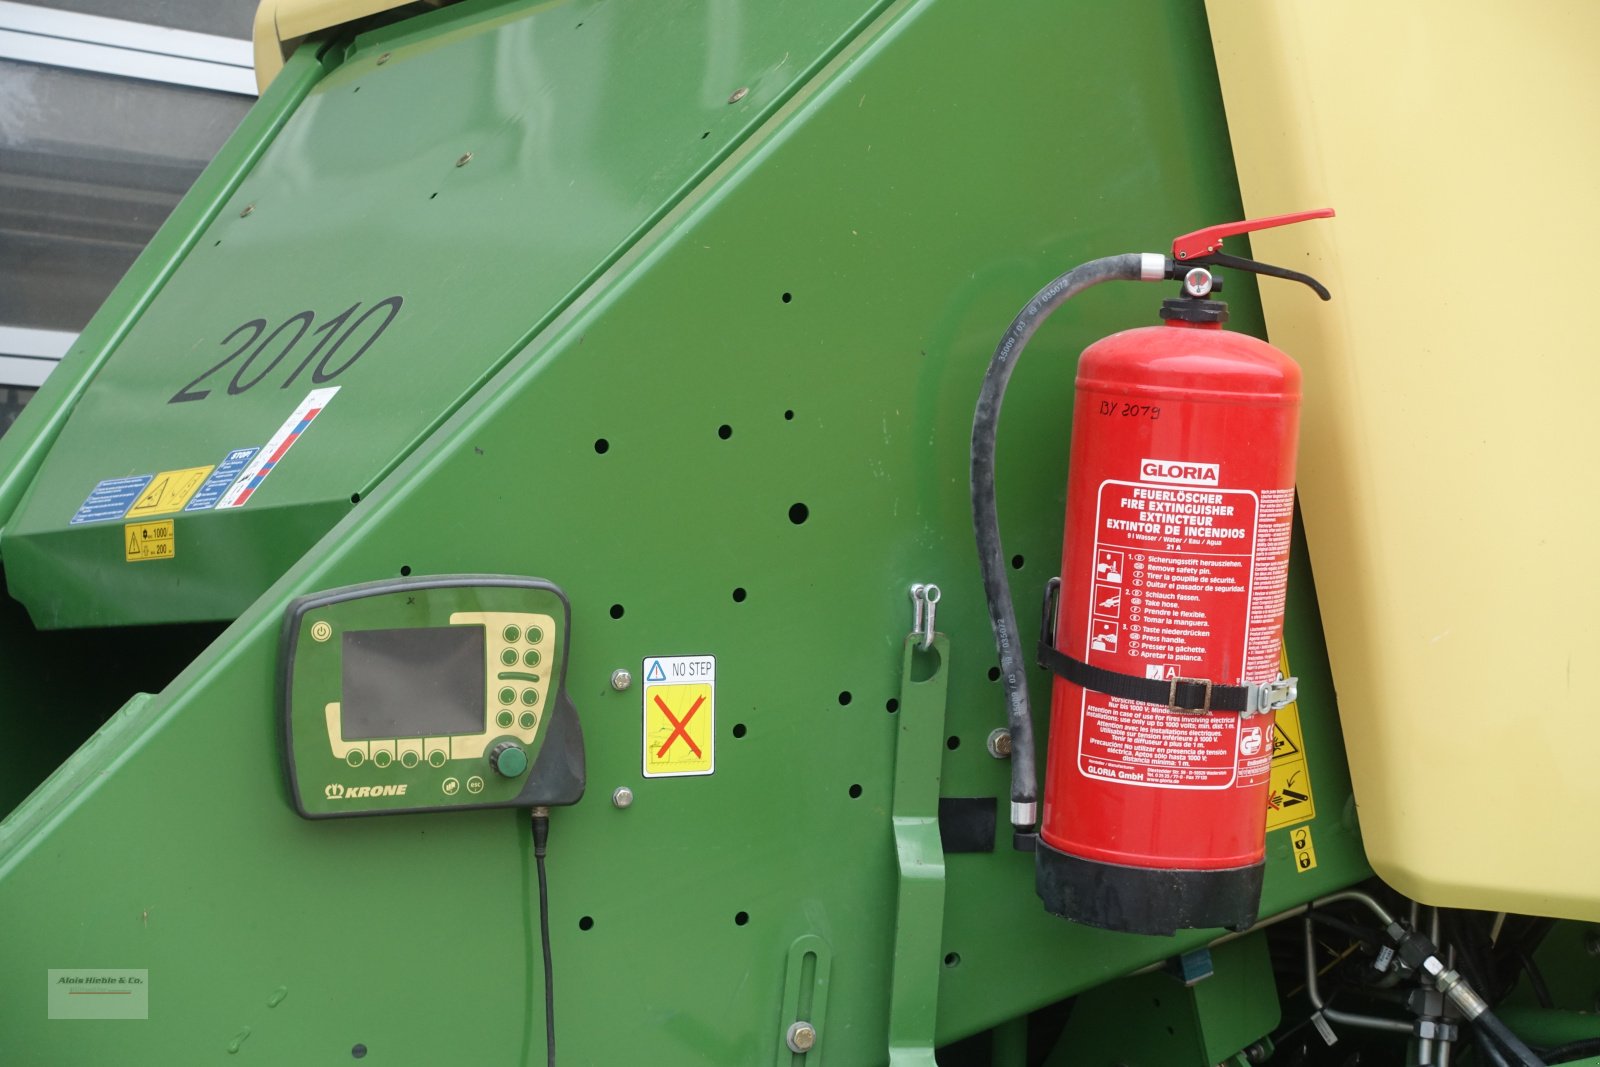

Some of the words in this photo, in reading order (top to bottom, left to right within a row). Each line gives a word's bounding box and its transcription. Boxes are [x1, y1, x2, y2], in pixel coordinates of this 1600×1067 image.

[999, 337, 1015, 361] 35009
[1016, 321, 1026, 332] 03
[167, 296, 403, 404] 2010
[1142, 463, 1216, 480] GLORIA
[1134, 488, 1222, 504] FEUERLÖSCHER
[1121, 498, 1144, 510] FIRE
[1149, 501, 1234, 516] EXTINGUISHER
[1140, 512, 1213, 526] EXTINCTEUR
[1107, 518, 1161, 534] EXTINTOR
[1164, 525, 1180, 536] DE
[1184, 527, 1246, 538] INCENDIOS
[1136, 534, 1157, 542] Wasser
[156, 544, 166, 554] 200
[1148, 556, 1198, 566] Sicherungsstift
[1172, 574, 1198, 582] goupille
[1176, 583, 1204, 591] pasador
[1146, 592, 1175, 600] Schlauch
[1144, 608, 1171, 616] Prendre
[1162, 628, 1210, 636] niederdrücken
[673, 662, 685, 676] NO
[689, 662, 712, 676] STEP
[1166, 666, 1176, 678] A
[1008, 674, 1016, 684] 03
[1088, 704, 1112, 714] Attention
[1097, 720, 1123, 729] Attention
[1150, 728, 1188, 736] installations
[1100, 726, 1125, 736] Utilisable
[1162, 734, 1192, 742] inférieure
[1088, 766, 1116, 777] GLORIA
[1118, 771, 1144, 780] GmbH
[345, 784, 408, 798] KRONE
